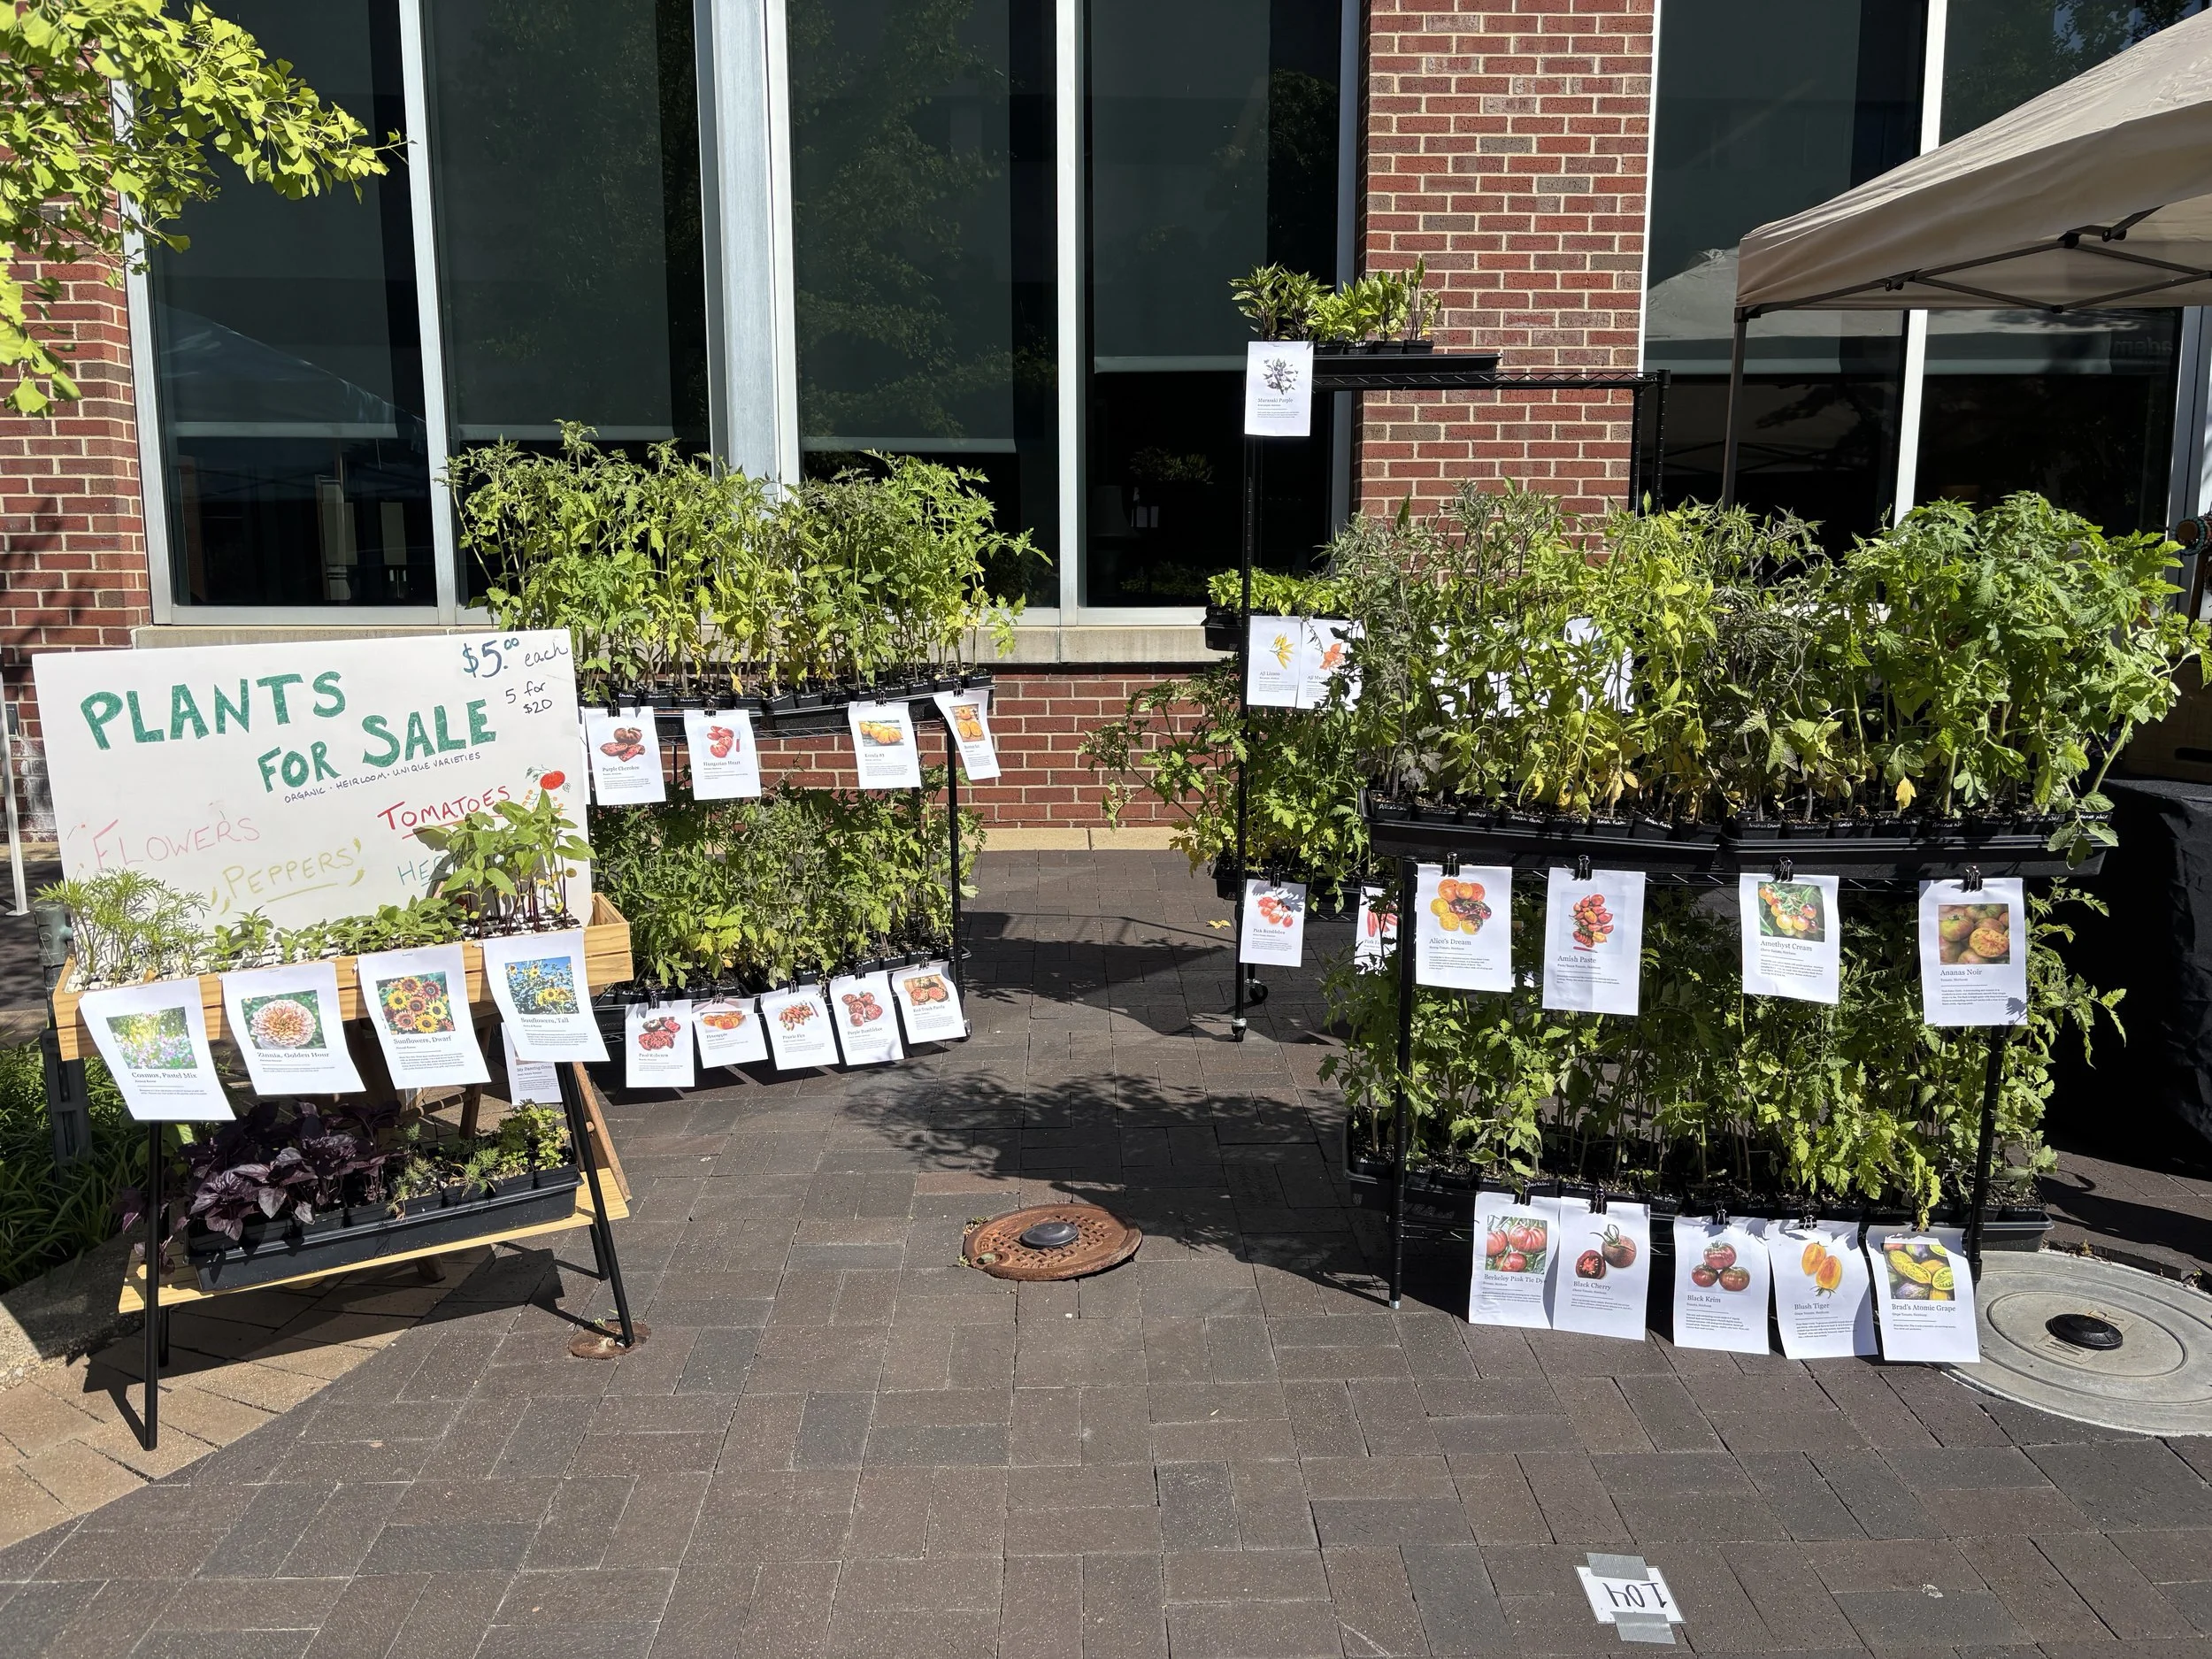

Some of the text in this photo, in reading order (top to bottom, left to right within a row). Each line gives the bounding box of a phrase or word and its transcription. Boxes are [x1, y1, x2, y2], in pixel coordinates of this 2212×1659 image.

[524, 642, 569, 667] each
[505, 680, 547, 704] 5 for
[80, 671, 346, 750] PLANTS
[523, 699, 553, 715] $20
[257, 698, 497, 794] FOR SALE
[284, 751, 481, 803] ORGANIC HEIRLOOM UNIQUE VARIETIES
[377, 785, 511, 831] TOMATOES
[93, 818, 260, 870] FLOWERS
[222, 846, 355, 900] PEPPERS
[1760, 940, 1813, 953] Amethyst Cream
[393, 1034, 452, 1045] Sunflowers, Dwarf
[1484, 1274, 1509, 1284] Berkeley
[1590, 1282, 1612, 1291] Cherry
